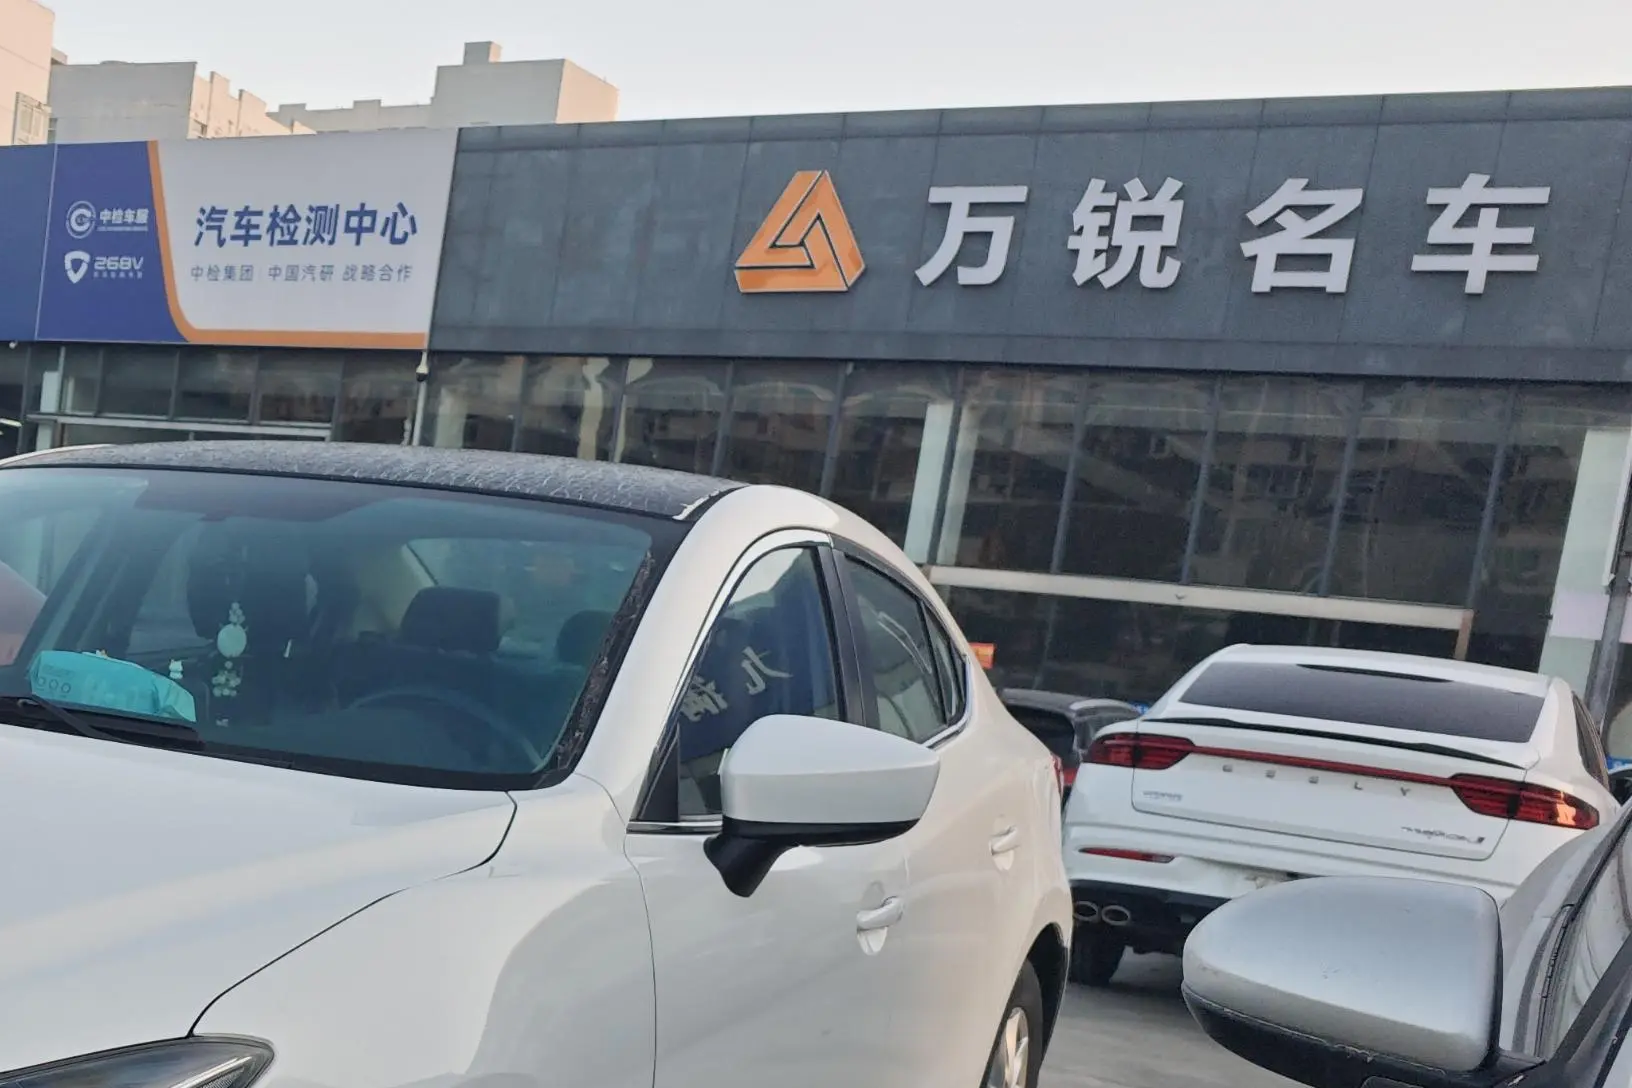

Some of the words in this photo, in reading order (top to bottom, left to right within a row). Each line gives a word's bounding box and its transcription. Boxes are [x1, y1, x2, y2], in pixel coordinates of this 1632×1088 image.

[194, 202, 417, 248] 汽车检测中心
[915, 174, 1551, 294] 万锐名车
[94, 256, 144, 270] 268V
[190, 264, 254, 282] 中检集团
[268, 264, 335, 282] 中国汽研
[342, 264, 413, 282] 战略合作
